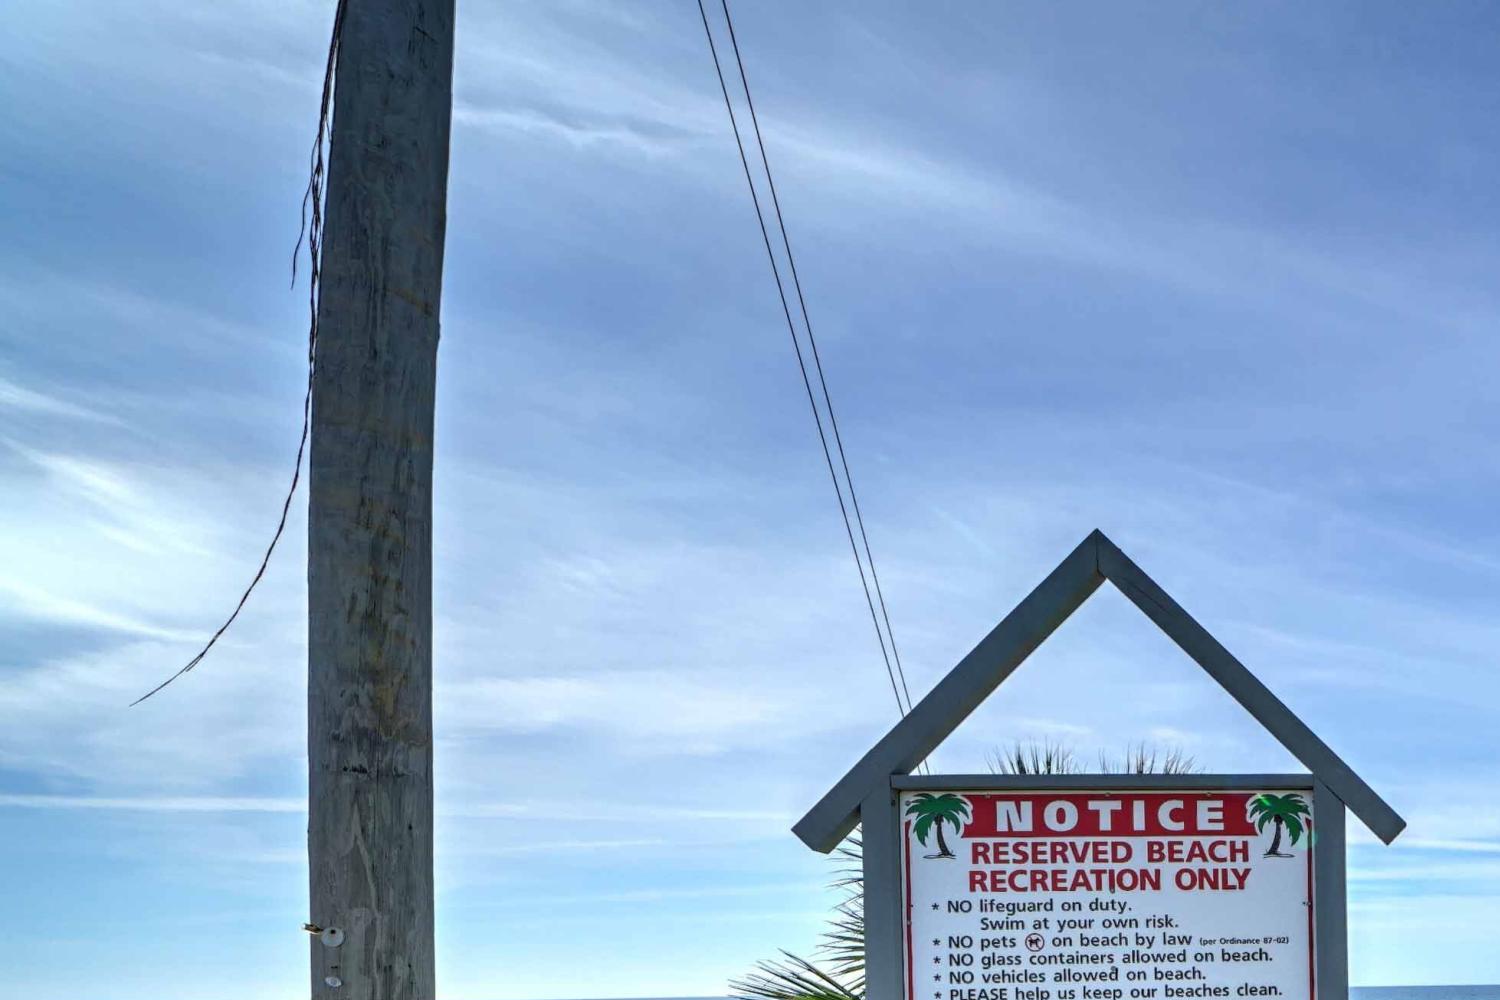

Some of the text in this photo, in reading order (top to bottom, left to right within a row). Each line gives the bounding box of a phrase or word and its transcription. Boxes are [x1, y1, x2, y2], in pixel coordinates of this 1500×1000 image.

[996, 799, 1225, 832] NOTICE
[971, 840, 1249, 864] RESERVED BEACH
[969, 868, 1252, 892] RECREATION ONLY
[947, 898, 1132, 916] NO lifeguard on duty.
[980, 914, 1179, 933] Swim at your own risk.
[948, 936, 973, 949] NO
[981, 936, 1017, 951] pets
[1052, 936, 1073, 947] on
[1080, 932, 1131, 947] beach
[1136, 932, 1155, 949] by
[1163, 932, 1193, 946] law
[1199, 938, 1216, 947] (per
[1219, 936, 1260, 945] Ordinance
[949, 947, 1273, 970] NO glass containers allowed on beach.
[949, 966, 1206, 984] NO vehicles allowed on beach.
[1057, 989, 1075, 1000] us
[1130, 987, 1158, 999] our
[1164, 984, 1230, 998] beaches
[1237, 982, 1283, 997] clean.
